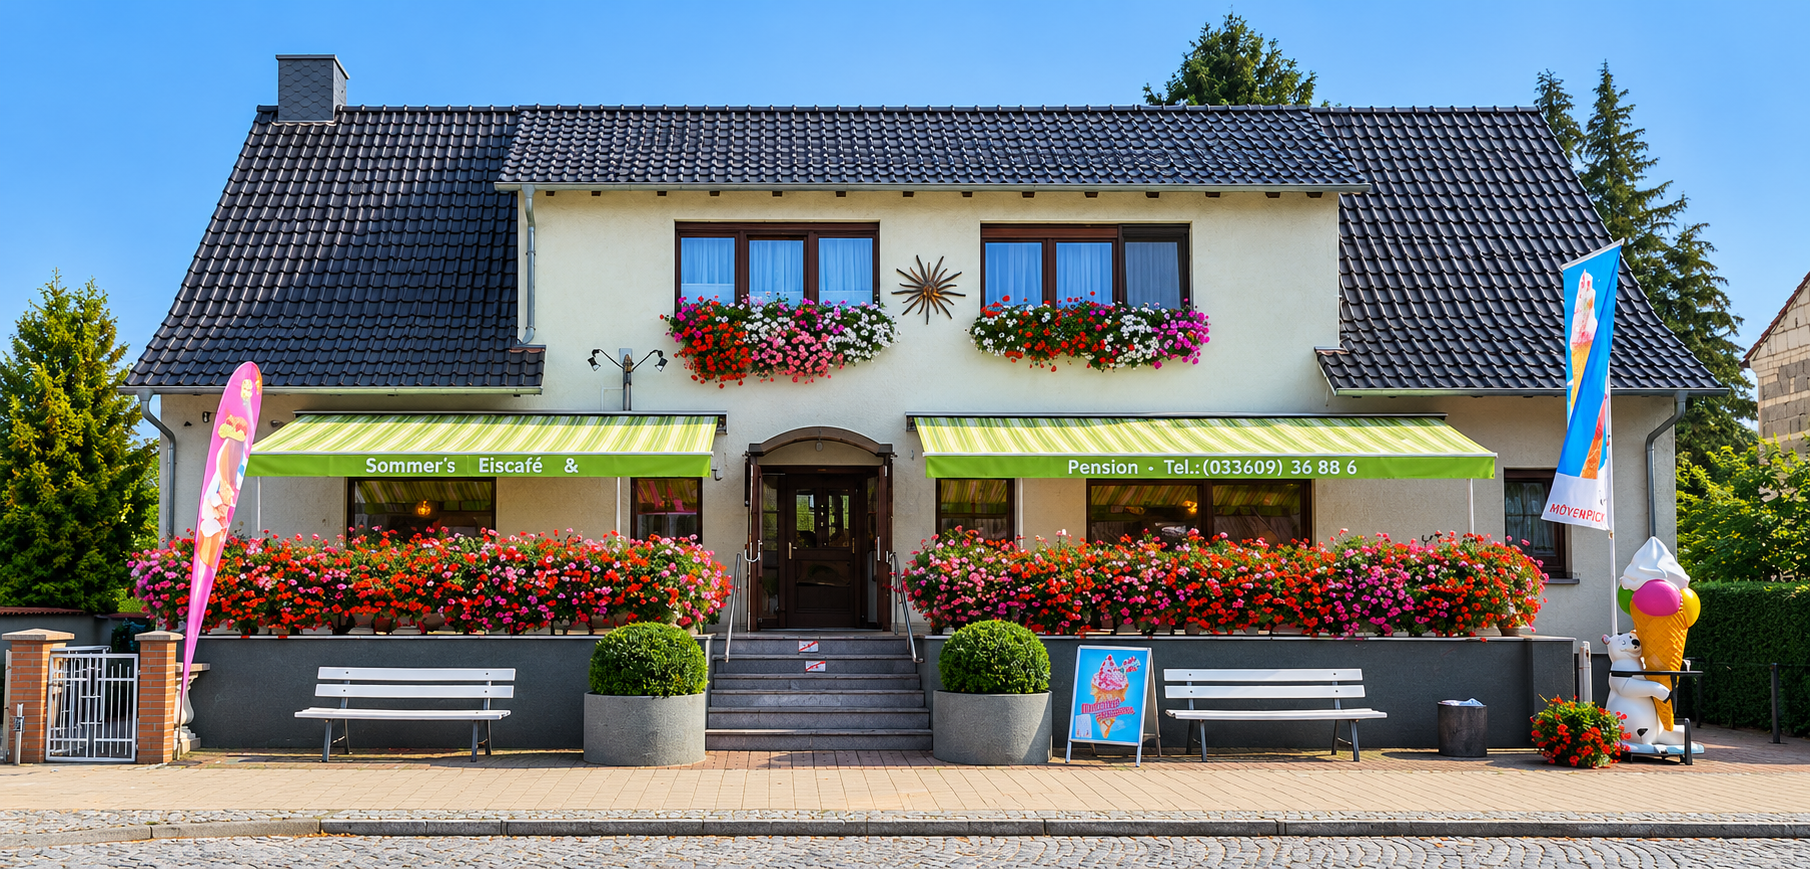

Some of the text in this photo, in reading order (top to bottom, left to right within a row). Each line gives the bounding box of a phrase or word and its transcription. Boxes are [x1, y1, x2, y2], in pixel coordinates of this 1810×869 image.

[365, 457, 579, 474] Sommer's Eiscafé &
[1068, 459, 1139, 475] Pension
[1290, 459, 1313, 475] 36
[1317, 459, 1341, 475] 88
[1346, 459, 1358, 475] 6
